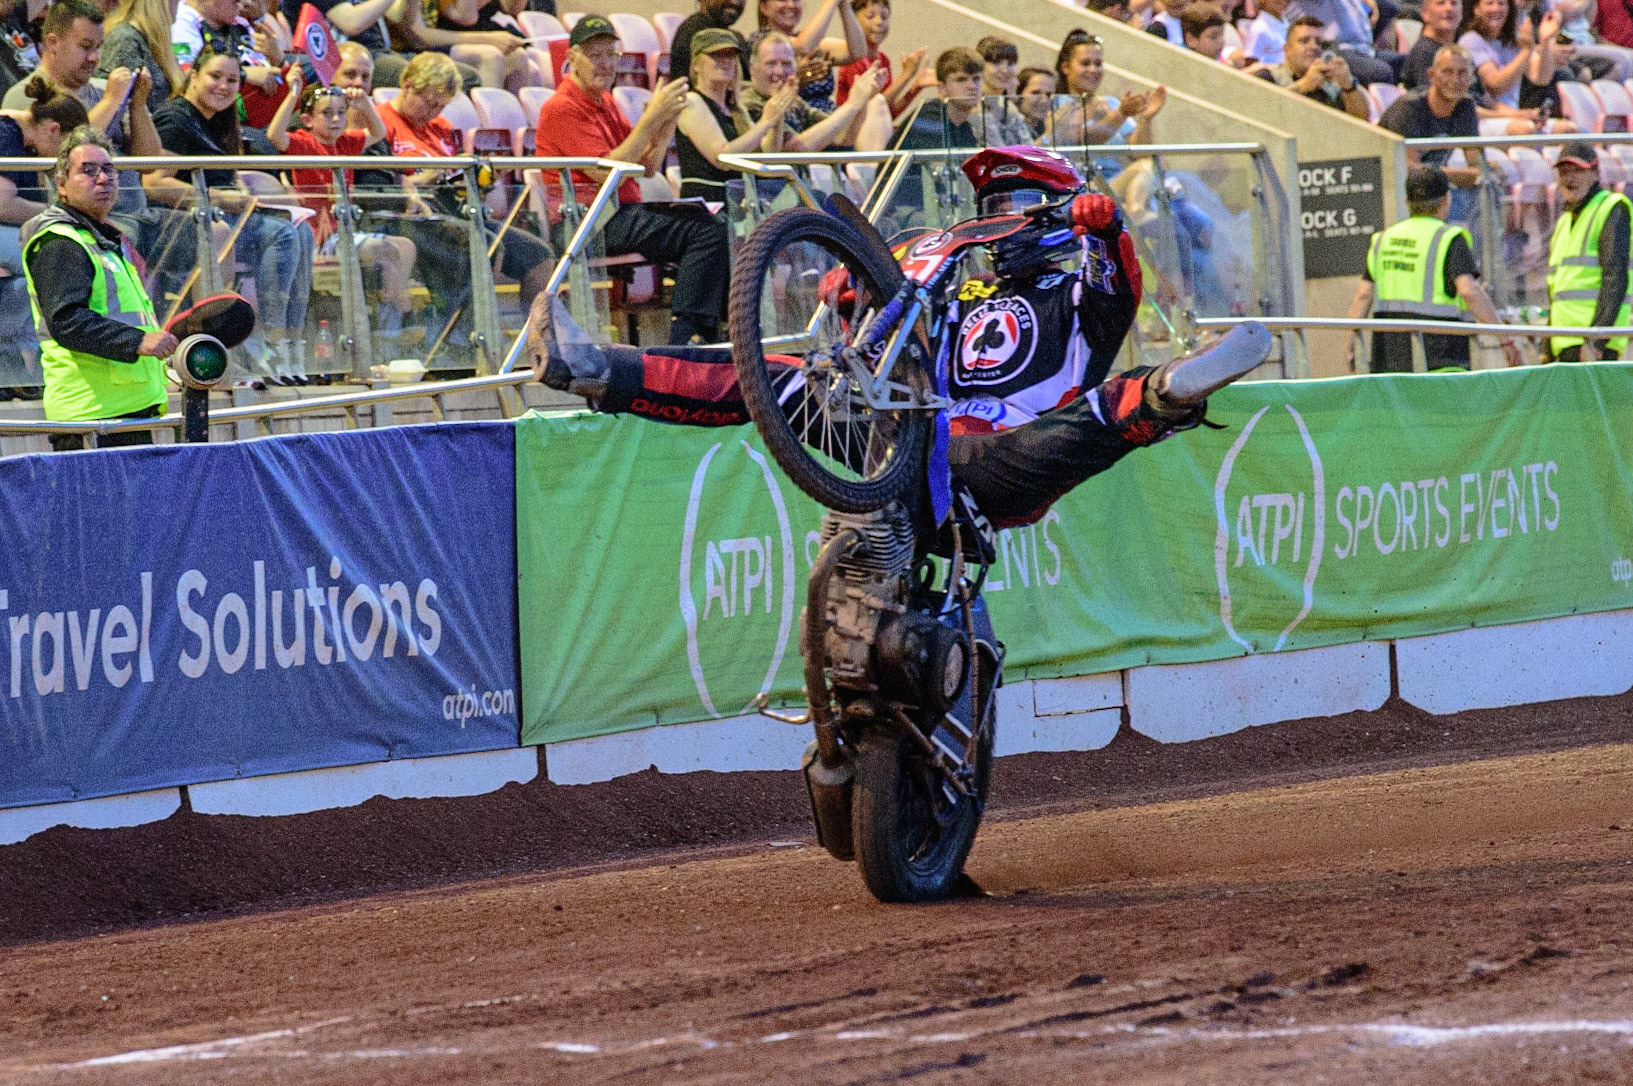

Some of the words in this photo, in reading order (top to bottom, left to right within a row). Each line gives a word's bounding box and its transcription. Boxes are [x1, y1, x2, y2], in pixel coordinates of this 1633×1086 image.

[1299, 168, 1337, 188] OCK
[1341, 166, 1353, 184] F
[1301, 210, 1338, 230] OCK
[1342, 208, 1358, 226] G
[1235, 492, 1305, 568] ATPI
[1334, 476, 1451, 560] SPORTS
[1459, 461, 1560, 544] EVENTS
[703, 535, 773, 620] ATPI
[1611, 556, 1633, 588] atp
[0, 571, 154, 698] ravel
[176, 556, 442, 678] Solutions
